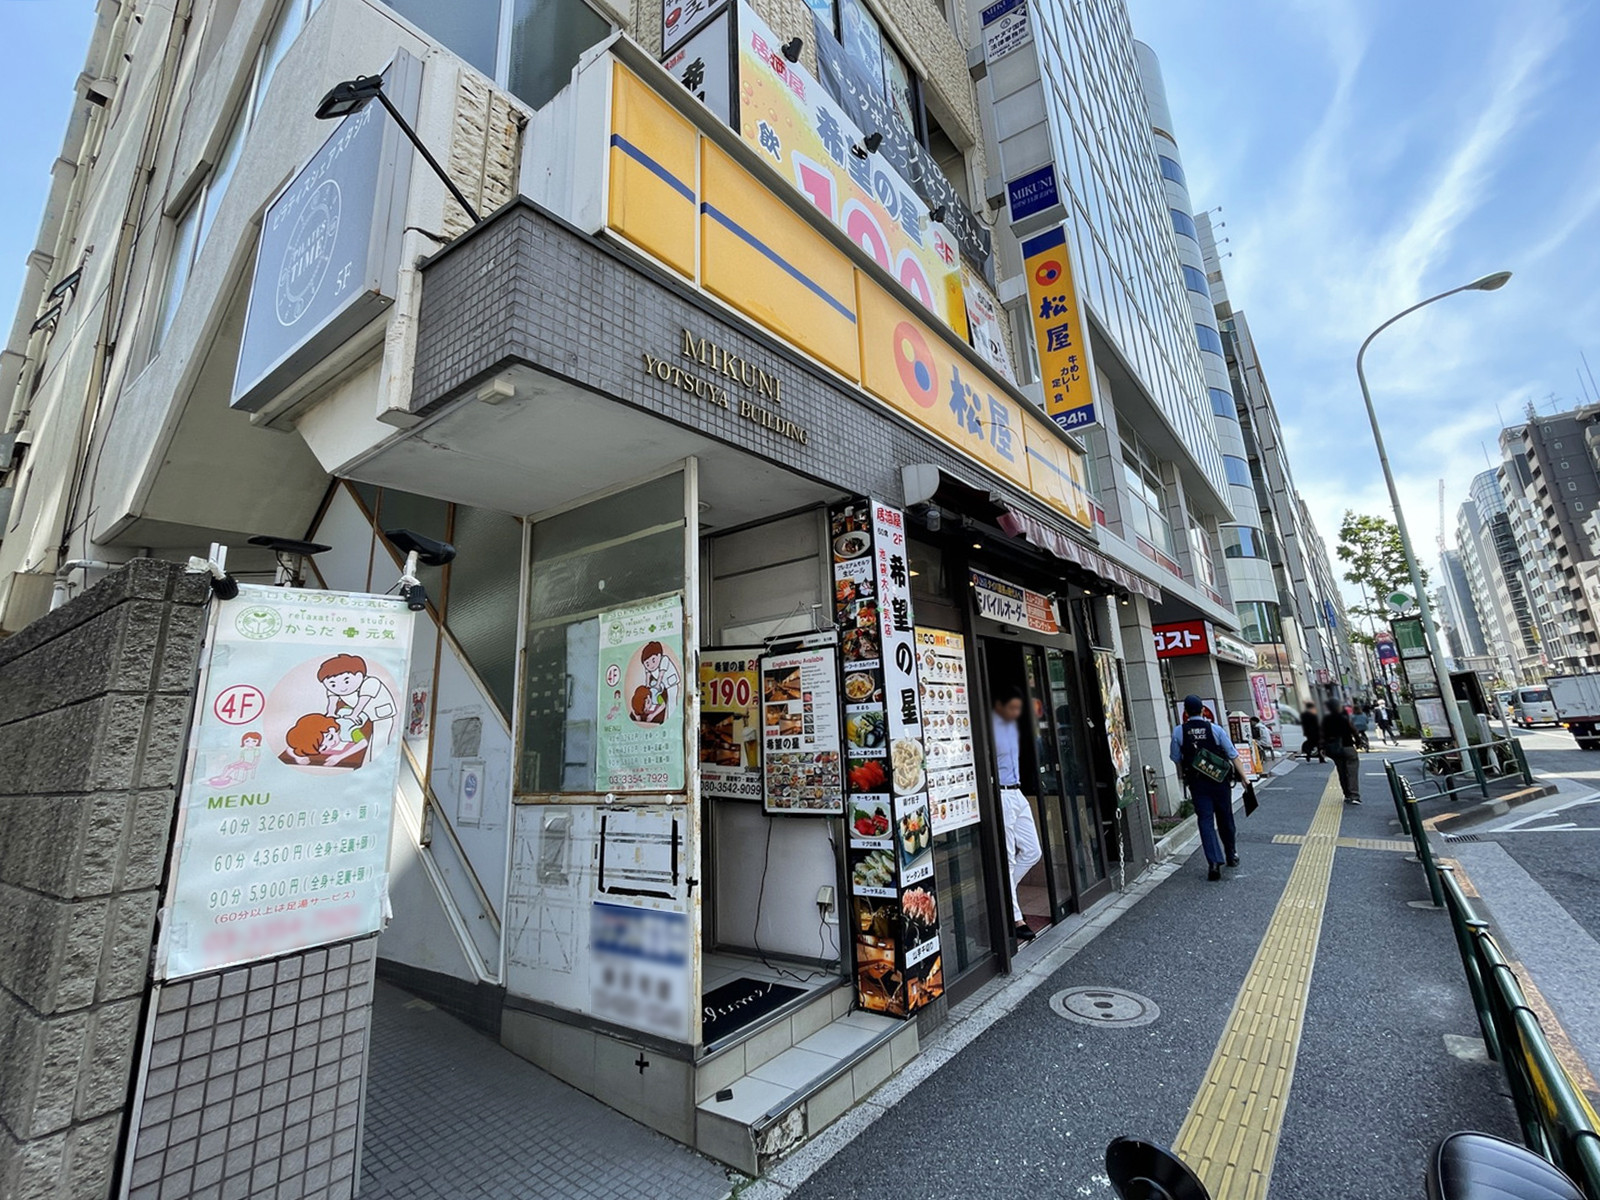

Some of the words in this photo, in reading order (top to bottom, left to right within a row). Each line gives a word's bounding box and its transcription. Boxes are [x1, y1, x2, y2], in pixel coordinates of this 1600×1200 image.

[1012, 176, 1053, 201] MIKUNI
[289, 238, 325, 283] TIME
[934, 231, 955, 267] 2F
[335, 262, 352, 296] 5F
[1039, 295, 1073, 353] 松屋
[683, 328, 782, 404] MIKUNI
[1068, 355, 1080, 382] 牛めし
[1051, 378, 1064, 404] 定食
[1060, 367, 1071, 393] カレー
[643, 354, 729, 410] YOTSUYA
[740, 400, 809, 445] BUILDING
[949, 364, 1015, 464] 松屋
[1056, 411, 1088, 429] 24h
[876, 508, 902, 529] 居酒屋
[893, 533, 903, 545] 2F
[288, 609, 348, 623] relaxation
[360, 614, 395, 626] studio
[285, 623, 335, 638] からだ
[365, 628, 396, 640] 元気
[889, 554, 919, 725] 希望の星
[607, 667, 619, 684] 4F
[709, 676, 750, 707] 190
[222, 693, 256, 719] 4F
[207, 793, 271, 810] MENU
[219, 818, 250, 836] 40分
[214, 853, 245, 872] 60分
[209, 889, 241, 909] 90分
